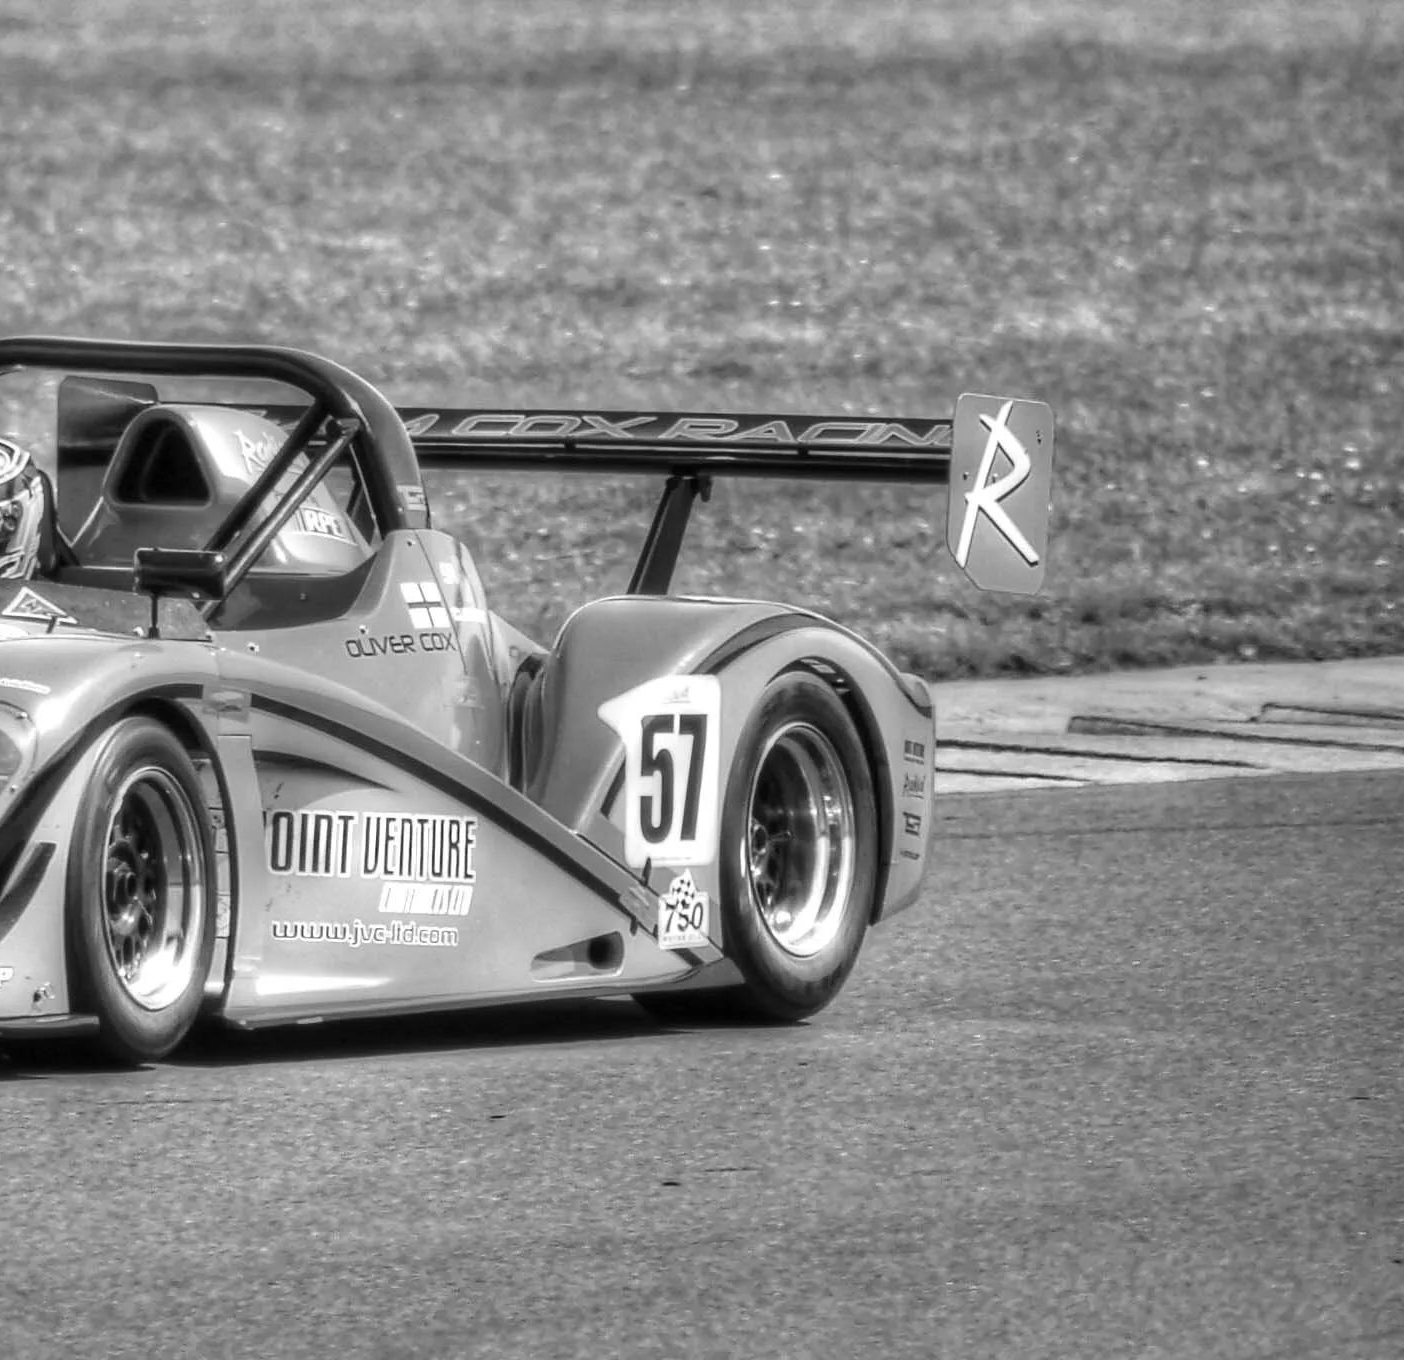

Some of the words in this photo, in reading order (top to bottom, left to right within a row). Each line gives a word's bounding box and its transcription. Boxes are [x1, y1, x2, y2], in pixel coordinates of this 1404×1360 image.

[451, 413, 659, 439] COX
[656, 417, 953, 446] RACIN
[955, 400, 1039, 568] R
[346, 633, 416, 658] OLIVER
[419, 632, 457, 653] COX
[640, 713, 708, 845] 57
[262, 810, 357, 876] OINT
[362, 813, 477, 881] VENTURE
[271, 917, 459, 947] www.jvc-ltd.com
[665, 901, 704, 933] 750
